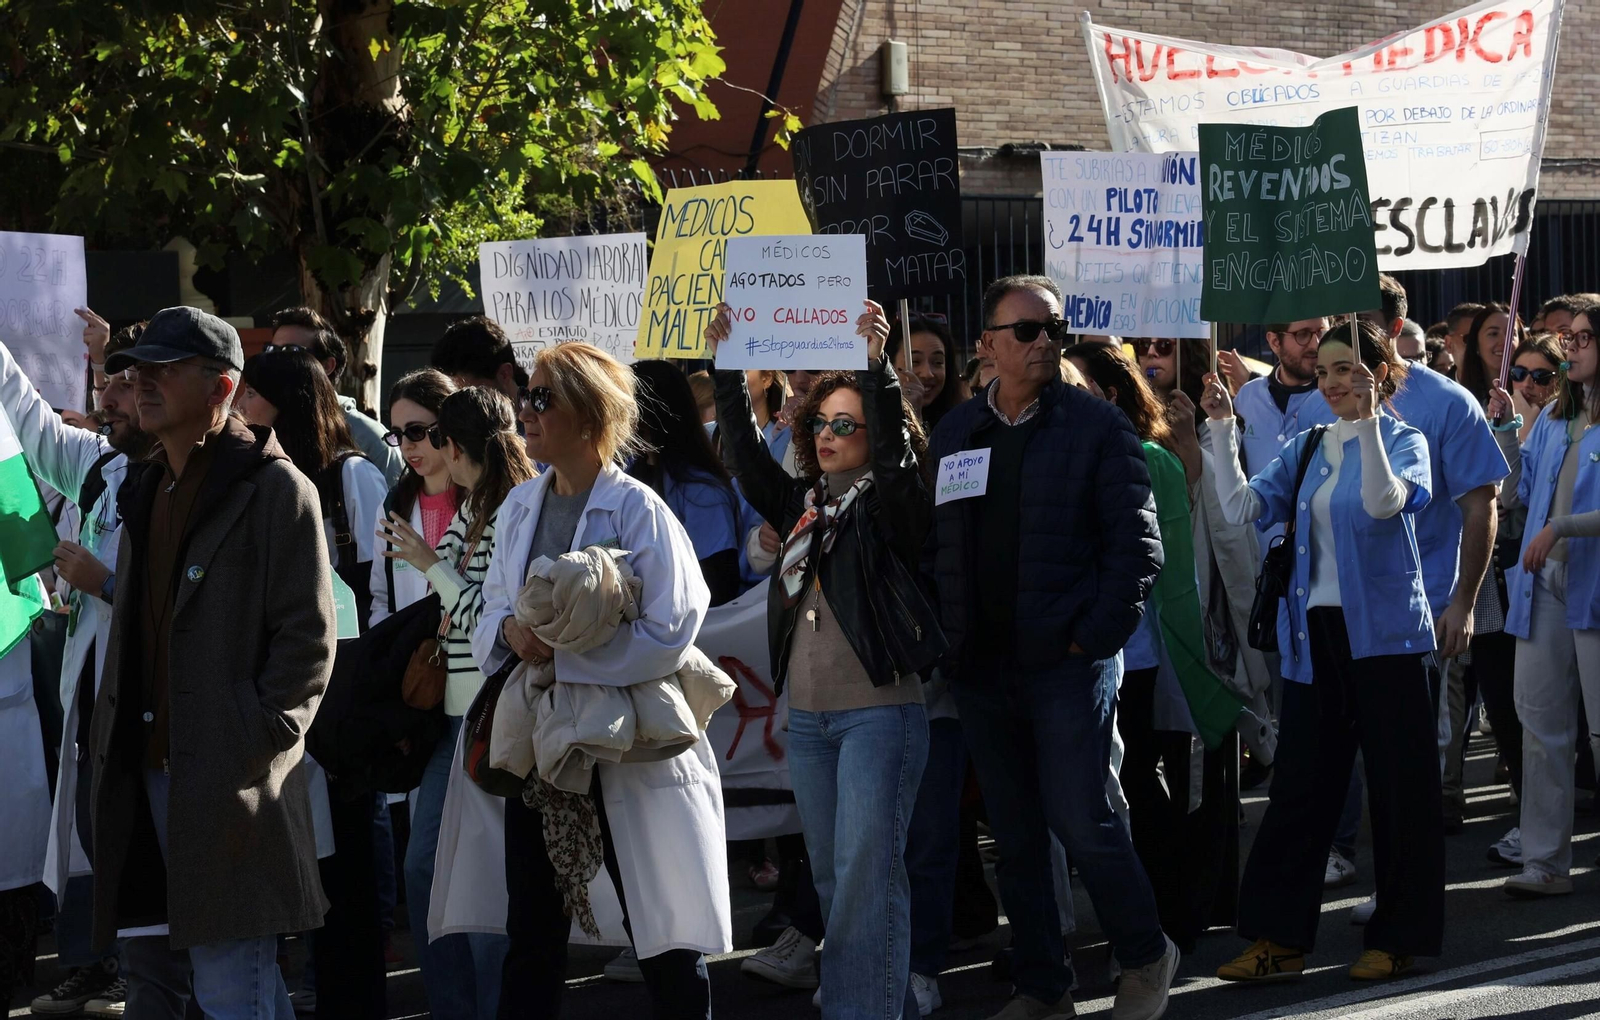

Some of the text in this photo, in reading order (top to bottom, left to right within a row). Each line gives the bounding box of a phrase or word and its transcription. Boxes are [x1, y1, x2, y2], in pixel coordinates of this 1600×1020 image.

[1350, 80, 1364, 96] A
[1378, 74, 1470, 92] GUARDIAS
[1484, 75, 1502, 88] DE
[1365, 109, 1396, 124] POR
[1403, 106, 1452, 121] DEBAJO
[1462, 106, 1476, 120] DE
[1481, 105, 1493, 119] LA
[833, 118, 941, 161] DORMIR
[1409, 144, 1472, 158] TRABAJAR
[1045, 157, 1068, 180] TE
[1136, 161, 1146, 183] A
[814, 157, 955, 207] SIN PARAR
[1048, 188, 1075, 210] CON
[1082, 188, 1098, 212] UN
[661, 194, 754, 239] MÉDICOS
[1226, 212, 1259, 243] EL
[587, 242, 645, 289] LABORAL
[885, 248, 965, 287] MATAR
[1049, 260, 1067, 280] NO
[1075, 262, 1124, 283] DEJES
[1212, 243, 1366, 292] ENCANTADO
[729, 271, 852, 289] AGOTADOS PERO
[492, 291, 539, 325] PARA
[543, 287, 575, 320] LOS
[1120, 293, 1138, 310] EN
[728, 307, 848, 325] NO CALLADOS
[538, 325, 587, 339] ESTATUTO
[944, 456, 984, 471] YO APOYO
[949, 474, 955, 482] A
